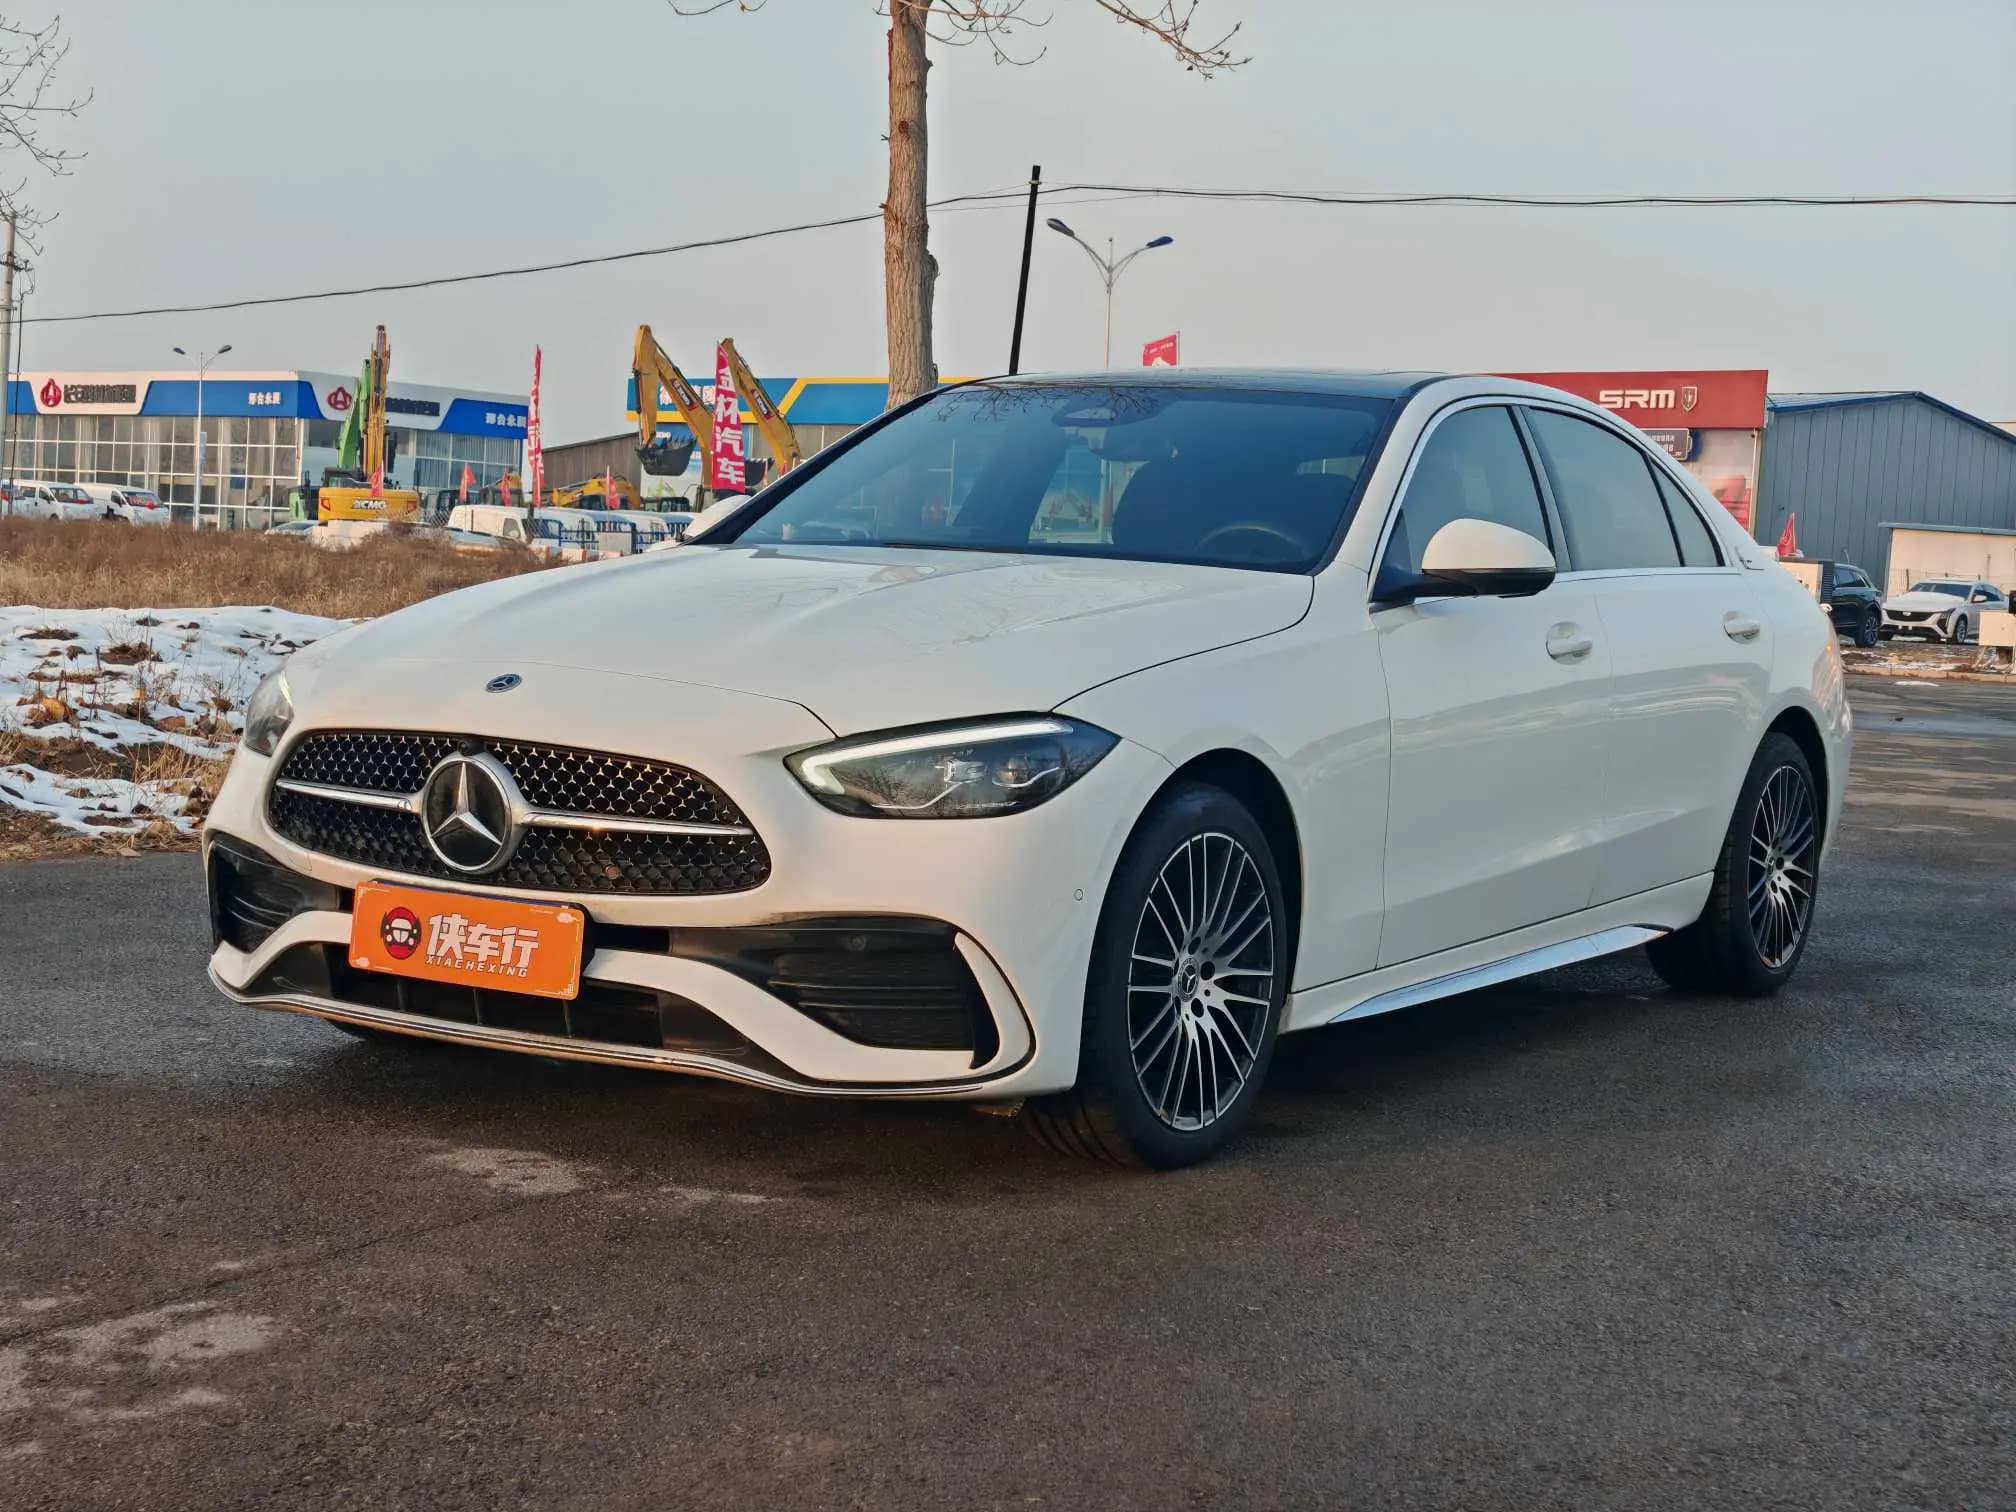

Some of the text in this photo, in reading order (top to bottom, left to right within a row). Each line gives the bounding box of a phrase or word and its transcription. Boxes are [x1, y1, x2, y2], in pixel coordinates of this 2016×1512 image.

[715, 366, 744, 484] 金杯汽车
[1599, 389, 1675, 409] SRM
[426, 913, 539, 969] 侠车行
